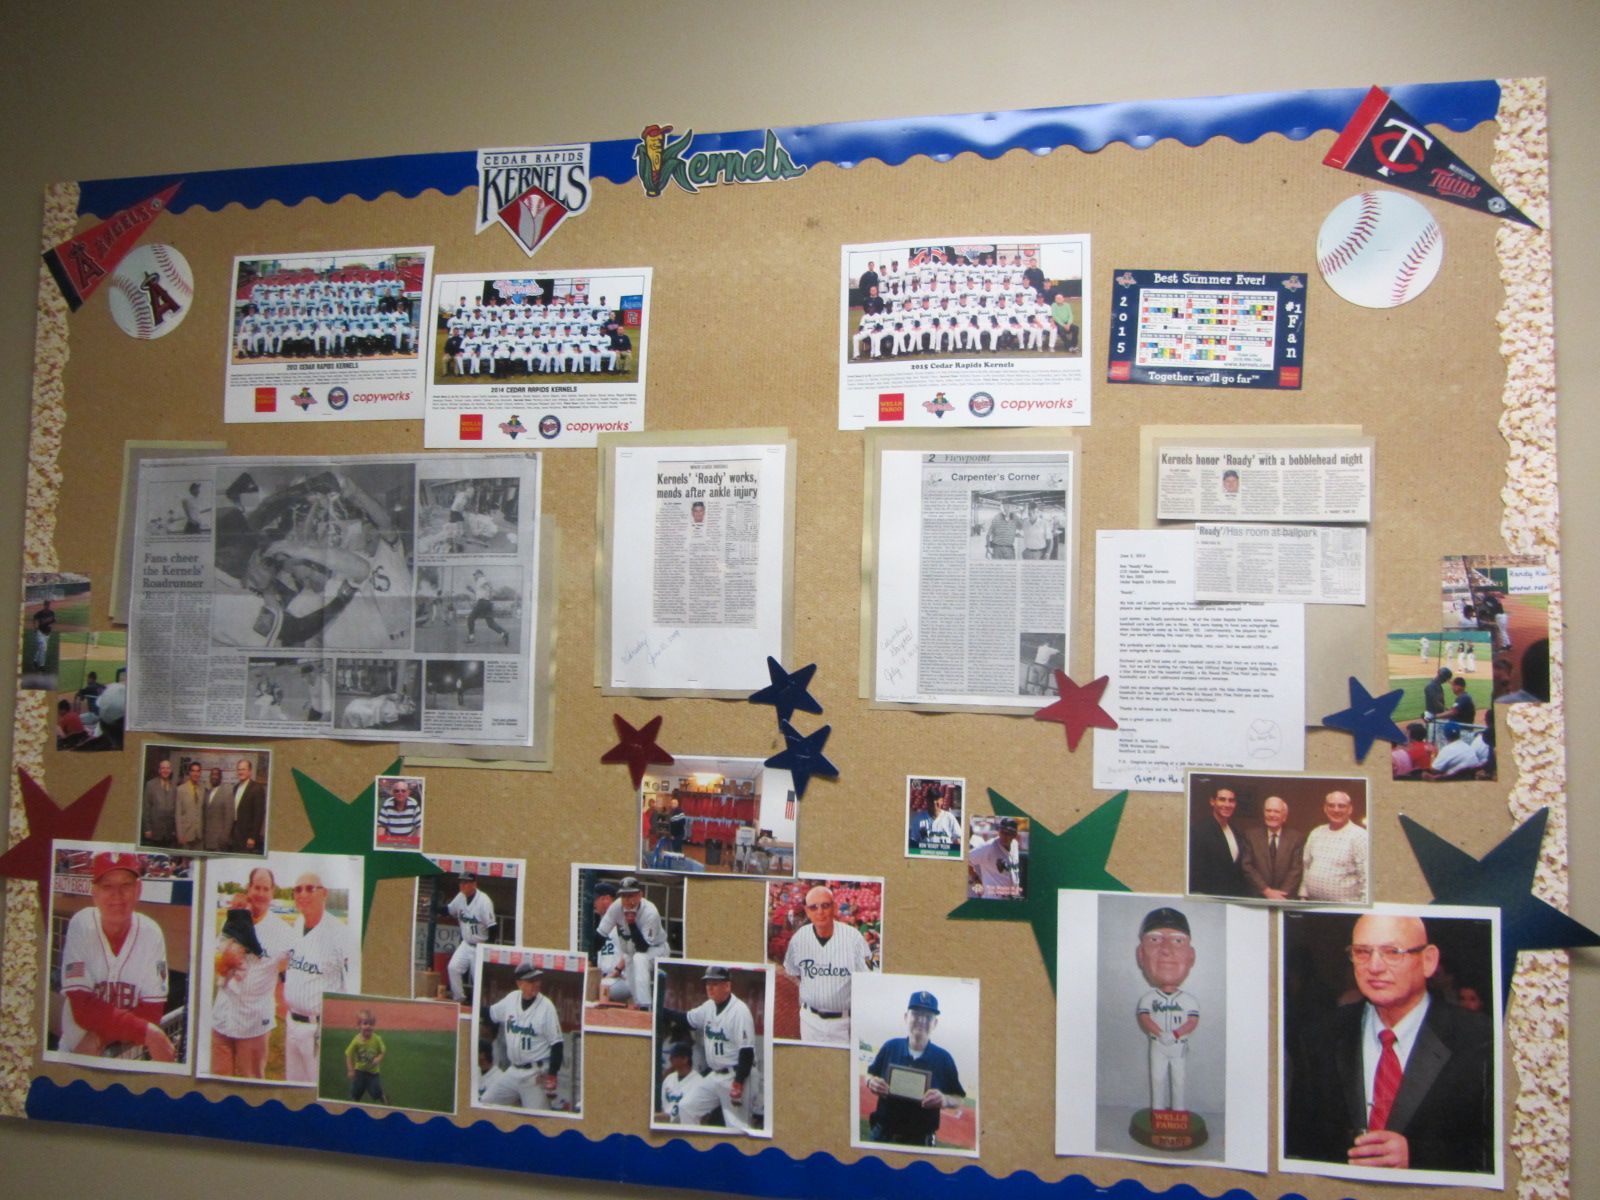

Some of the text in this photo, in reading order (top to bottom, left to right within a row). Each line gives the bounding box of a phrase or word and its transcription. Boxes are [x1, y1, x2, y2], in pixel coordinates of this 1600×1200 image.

[483, 152, 584, 166] CEDAR RAPIDS
[637, 127, 806, 197] Kernels
[1429, 167, 1482, 200] Twins
[481, 165, 586, 224] KERNELS
[1153, 273, 1266, 286] Best Summer Ever!
[930, 362, 953, 370] Cedar
[955, 361, 982, 370] Rapids
[983, 361, 1014, 369] Kernels
[1148, 371, 1194, 383] Together
[1196, 372, 1220, 383] we'll
[1221, 375, 1235, 385] go
[551, 385, 577, 393] KERNELS
[353, 390, 411, 404] copyworks
[1001, 397, 1073, 411] copyworks
[566, 420, 630, 433] copyworks
[928, 454, 936, 462] 2
[1161, 453, 1193, 465] Kernels
[1196, 454, 1220, 465] honor
[1259, 454, 1277, 465] with
[1280, 457, 1286, 465] a
[1288, 453, 1337, 466] bobblehead
[1341, 453, 1364, 467] night
[729, 471, 757, 484] works,
[951, 472, 1041, 482] Carpenter's Corner
[657, 486, 758, 499] mends after ankle injury
[1245, 529, 1269, 537] room
[144, 552, 199, 563] Fans cheer
[143, 566, 160, 576] the
[142, 577, 204, 588] Roadrunner
[521, 1037, 532, 1050] 11
[713, 1041, 724, 1055] 11
